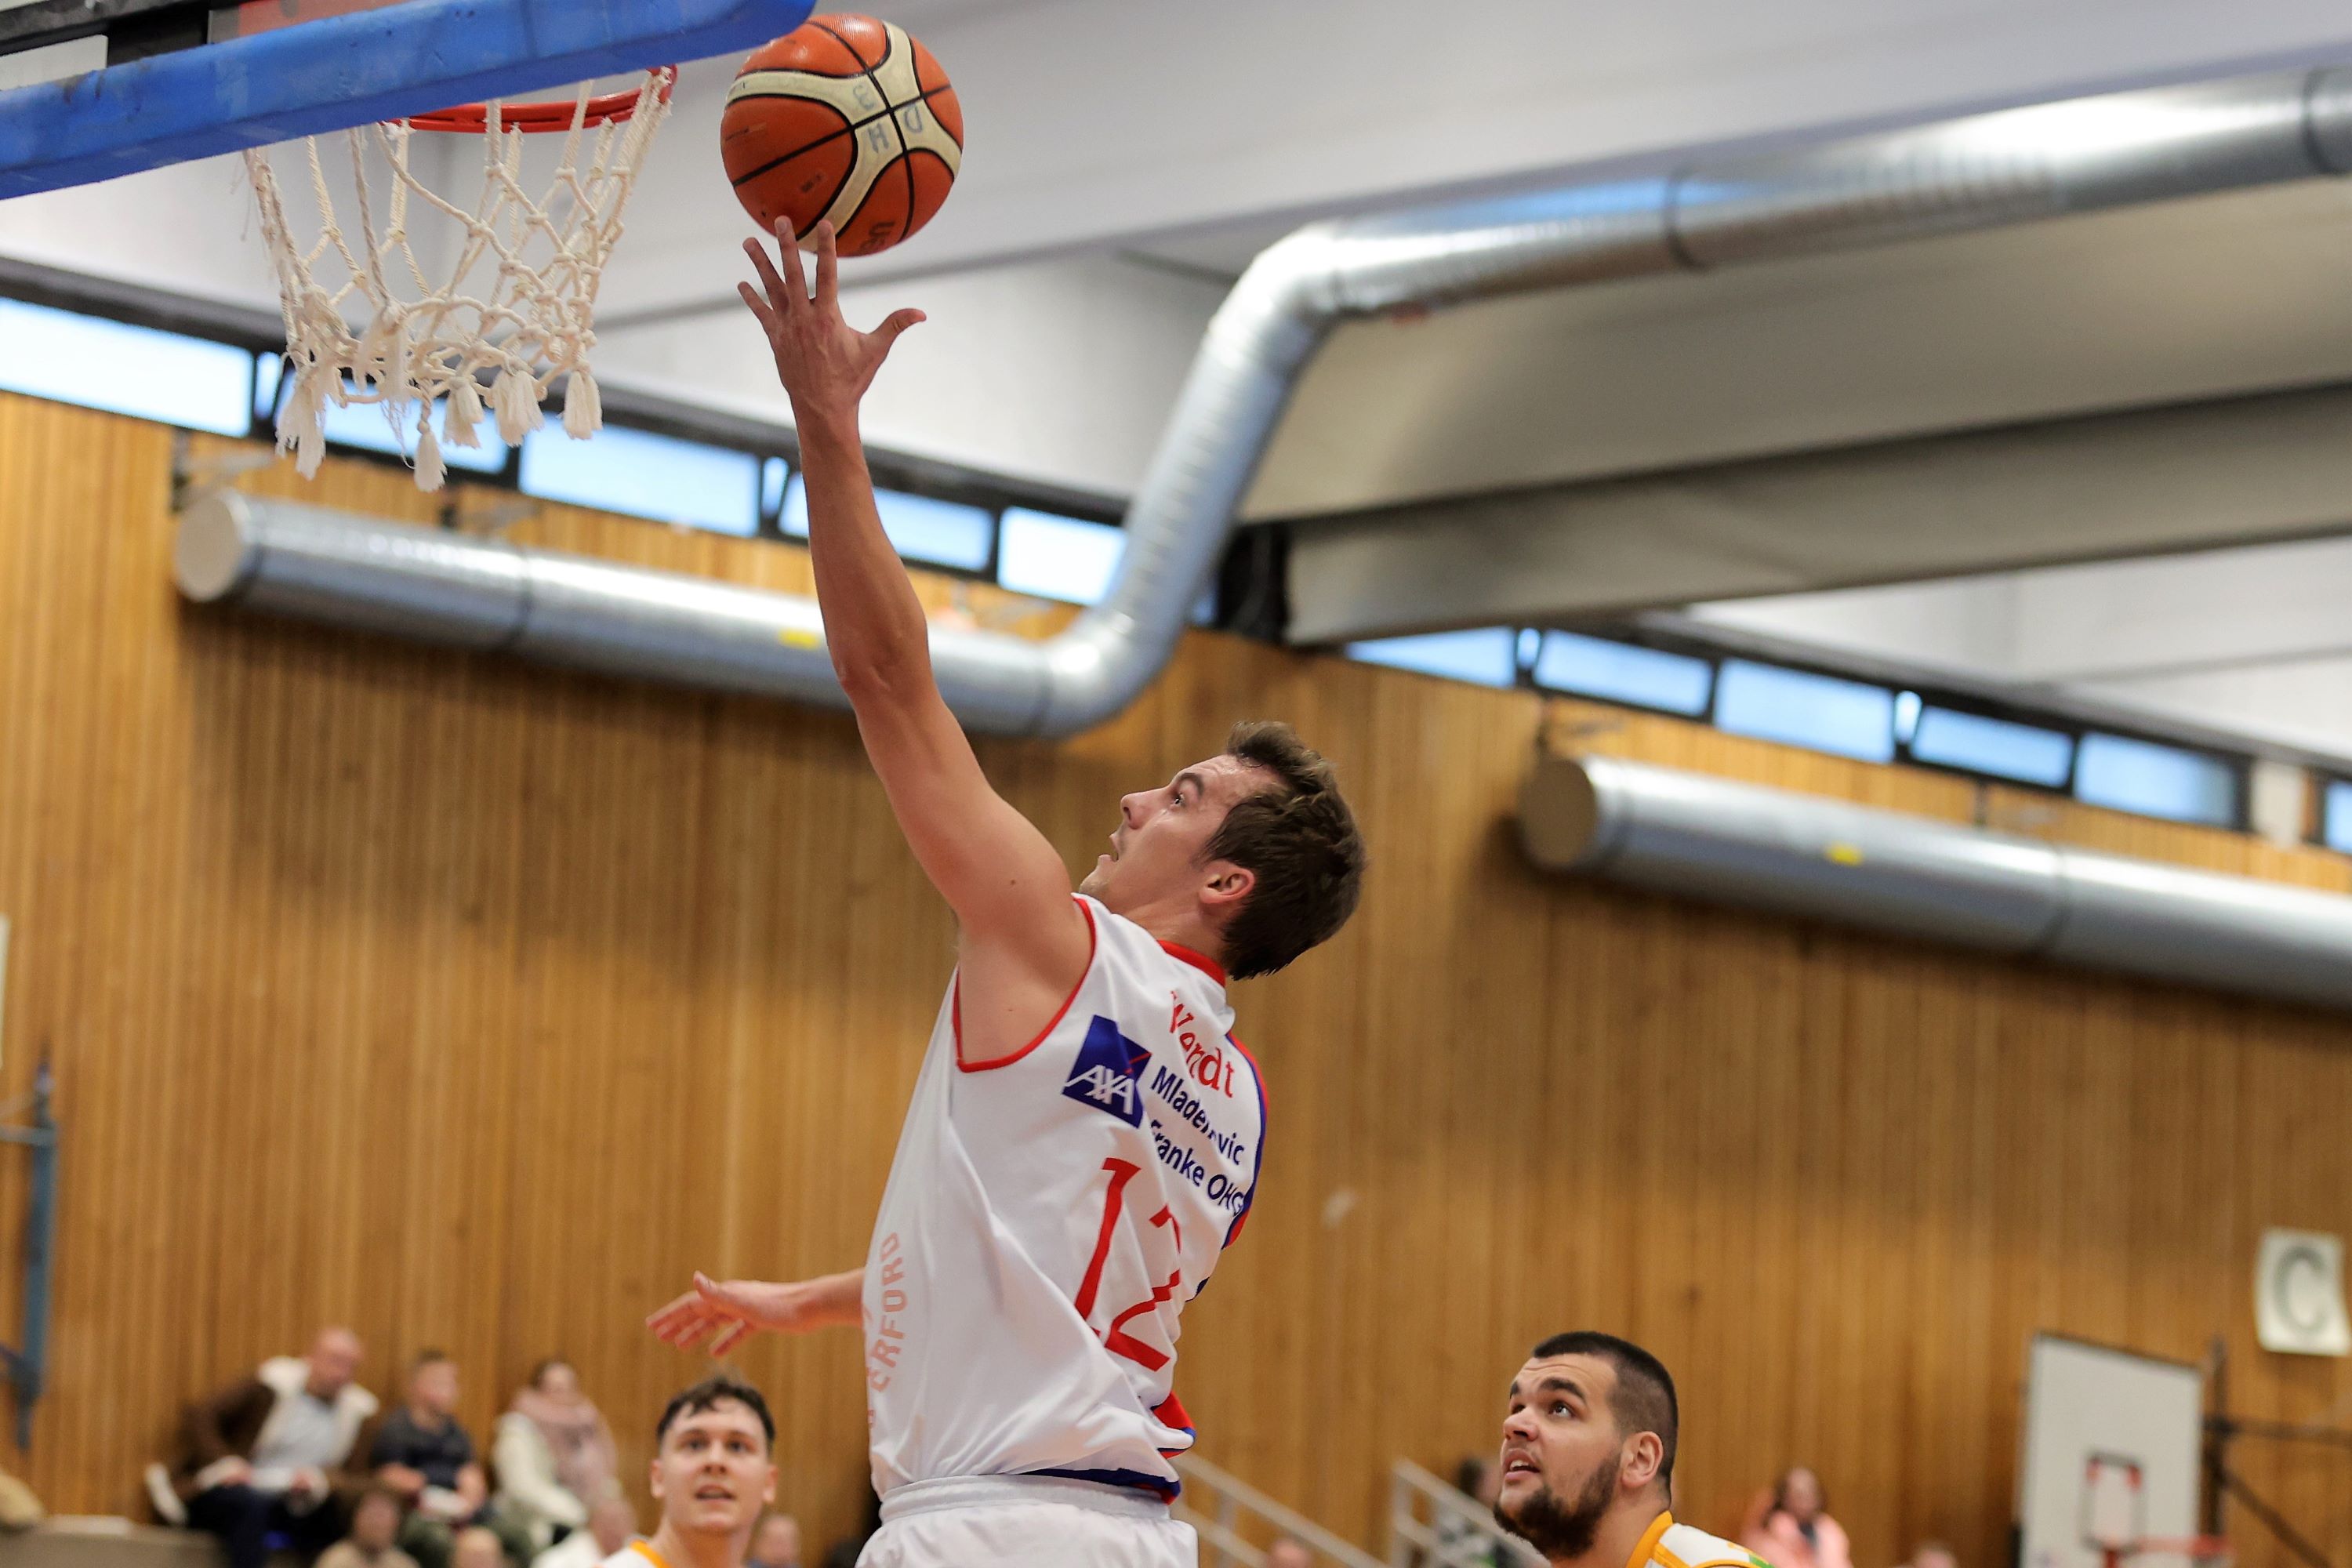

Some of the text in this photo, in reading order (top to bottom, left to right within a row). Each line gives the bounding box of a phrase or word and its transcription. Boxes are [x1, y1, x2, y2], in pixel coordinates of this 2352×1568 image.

[1065, 1064, 1135, 1115] AXA
[867, 1232, 908, 1429] ERFORD
[1075, 1157, 1181, 1372] 12
